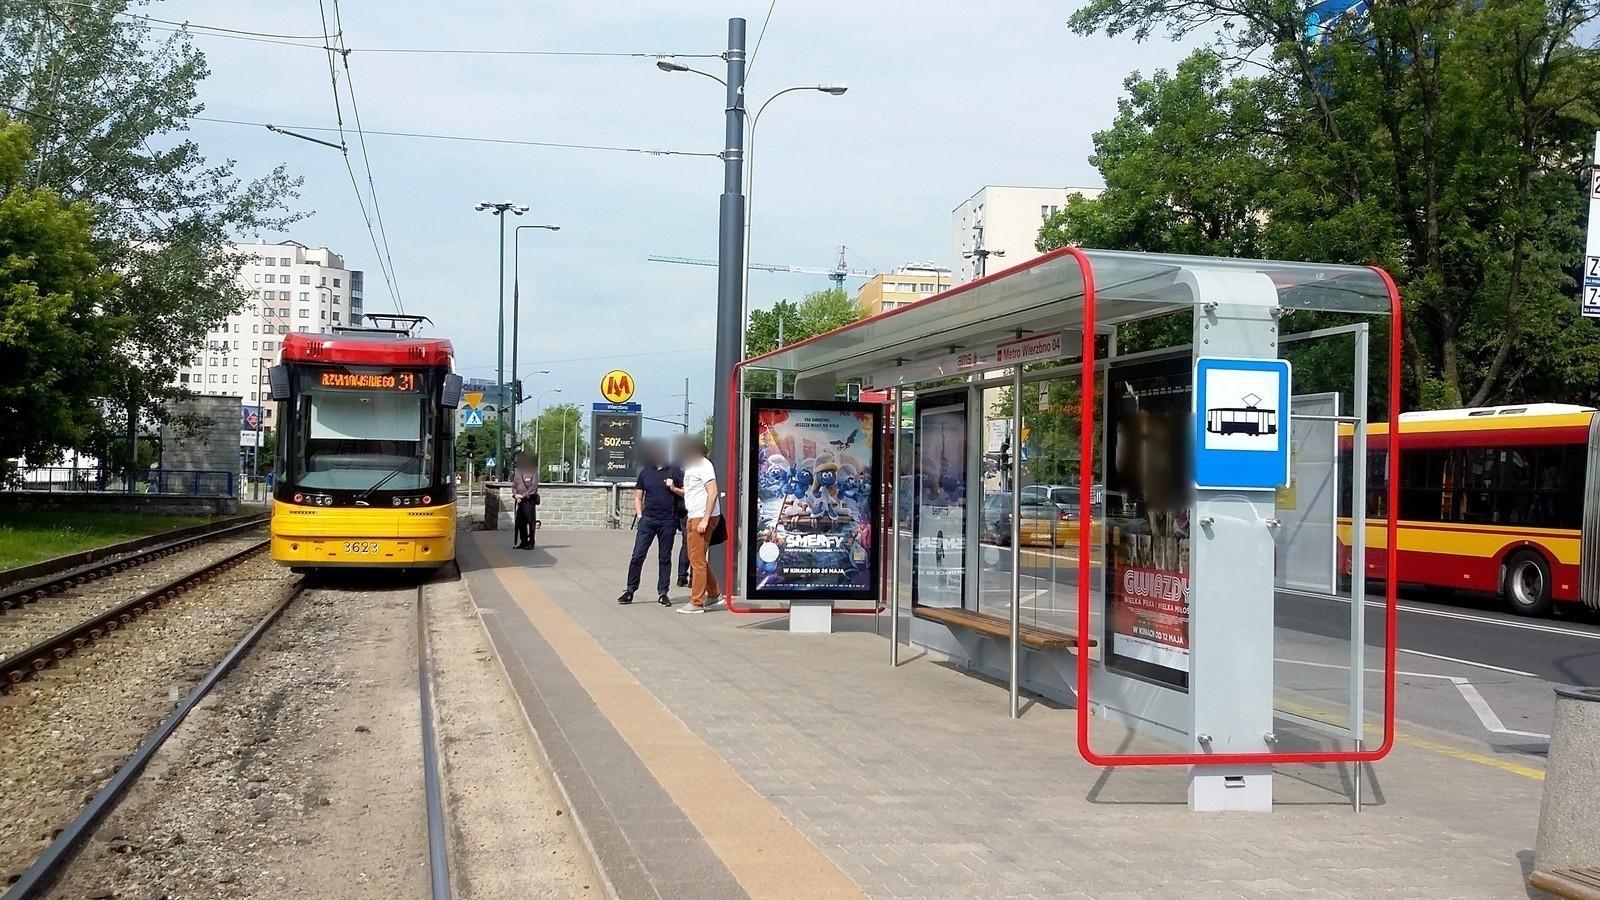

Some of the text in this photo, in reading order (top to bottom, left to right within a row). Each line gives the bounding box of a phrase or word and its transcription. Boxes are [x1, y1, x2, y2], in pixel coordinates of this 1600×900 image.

[1003, 347, 1020, 360] Metro
[1022, 341, 1051, 358] Wierzbno
[1052, 338, 1060, 351] 04
[398, 374, 414, 391] 31
[607, 375, 630, 397] M
[604, 437, 621, 447] 50%
[343, 541, 378, 553] 3623
[786, 534, 844, 548] SMERFY
[1124, 569, 1190, 603] GWIAZDY
[1124, 596, 1141, 605] WIELKA
[1132, 625, 1139, 634] W
[1139, 627, 1155, 638] KINACH
[1155, 631, 1162, 640] OD
[1169, 634, 1184, 645] MAJA
